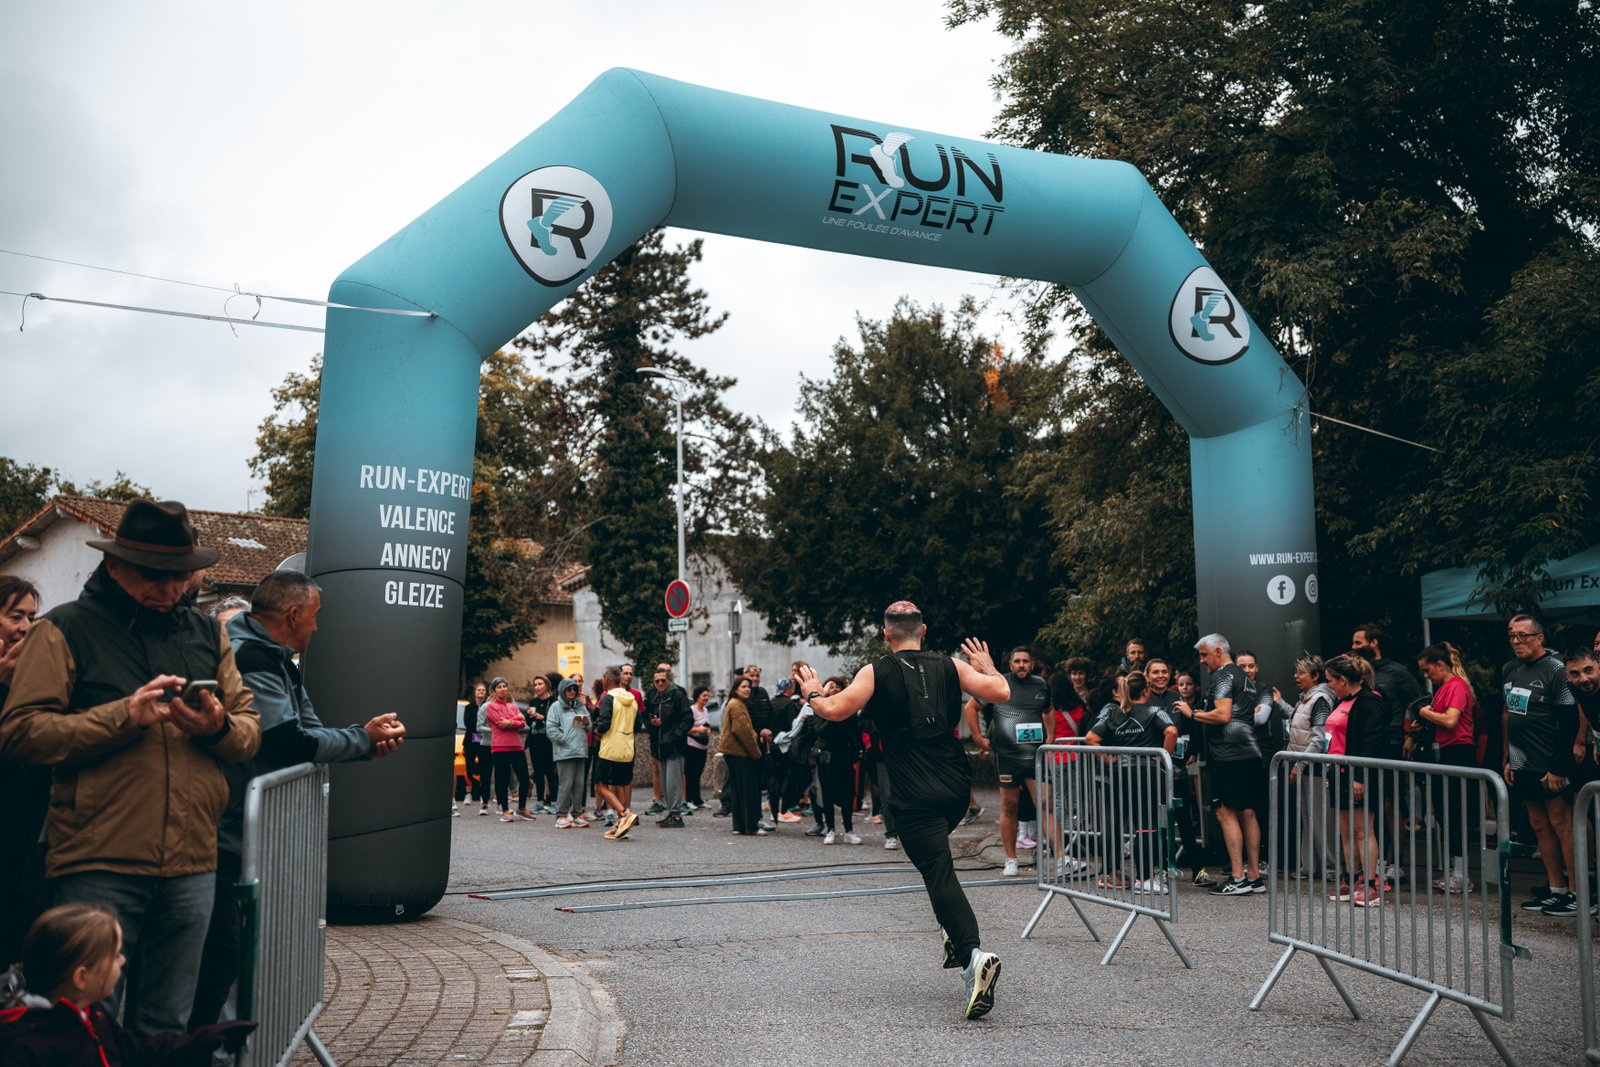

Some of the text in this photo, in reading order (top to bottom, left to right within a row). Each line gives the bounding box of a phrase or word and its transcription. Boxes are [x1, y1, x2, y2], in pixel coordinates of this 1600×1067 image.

[830, 124, 1004, 203] RUN
[828, 179, 1005, 235] EXPERT
[822, 216, 943, 242] UNE FOULÉE D'AVANCE
[360, 464, 471, 501] RUN-EXPERT
[379, 504, 456, 535] VALENCE
[380, 542, 451, 571] ANNECY
[384, 580, 444, 608] GLEIZE
[1023, 729, 1036, 739] 51
